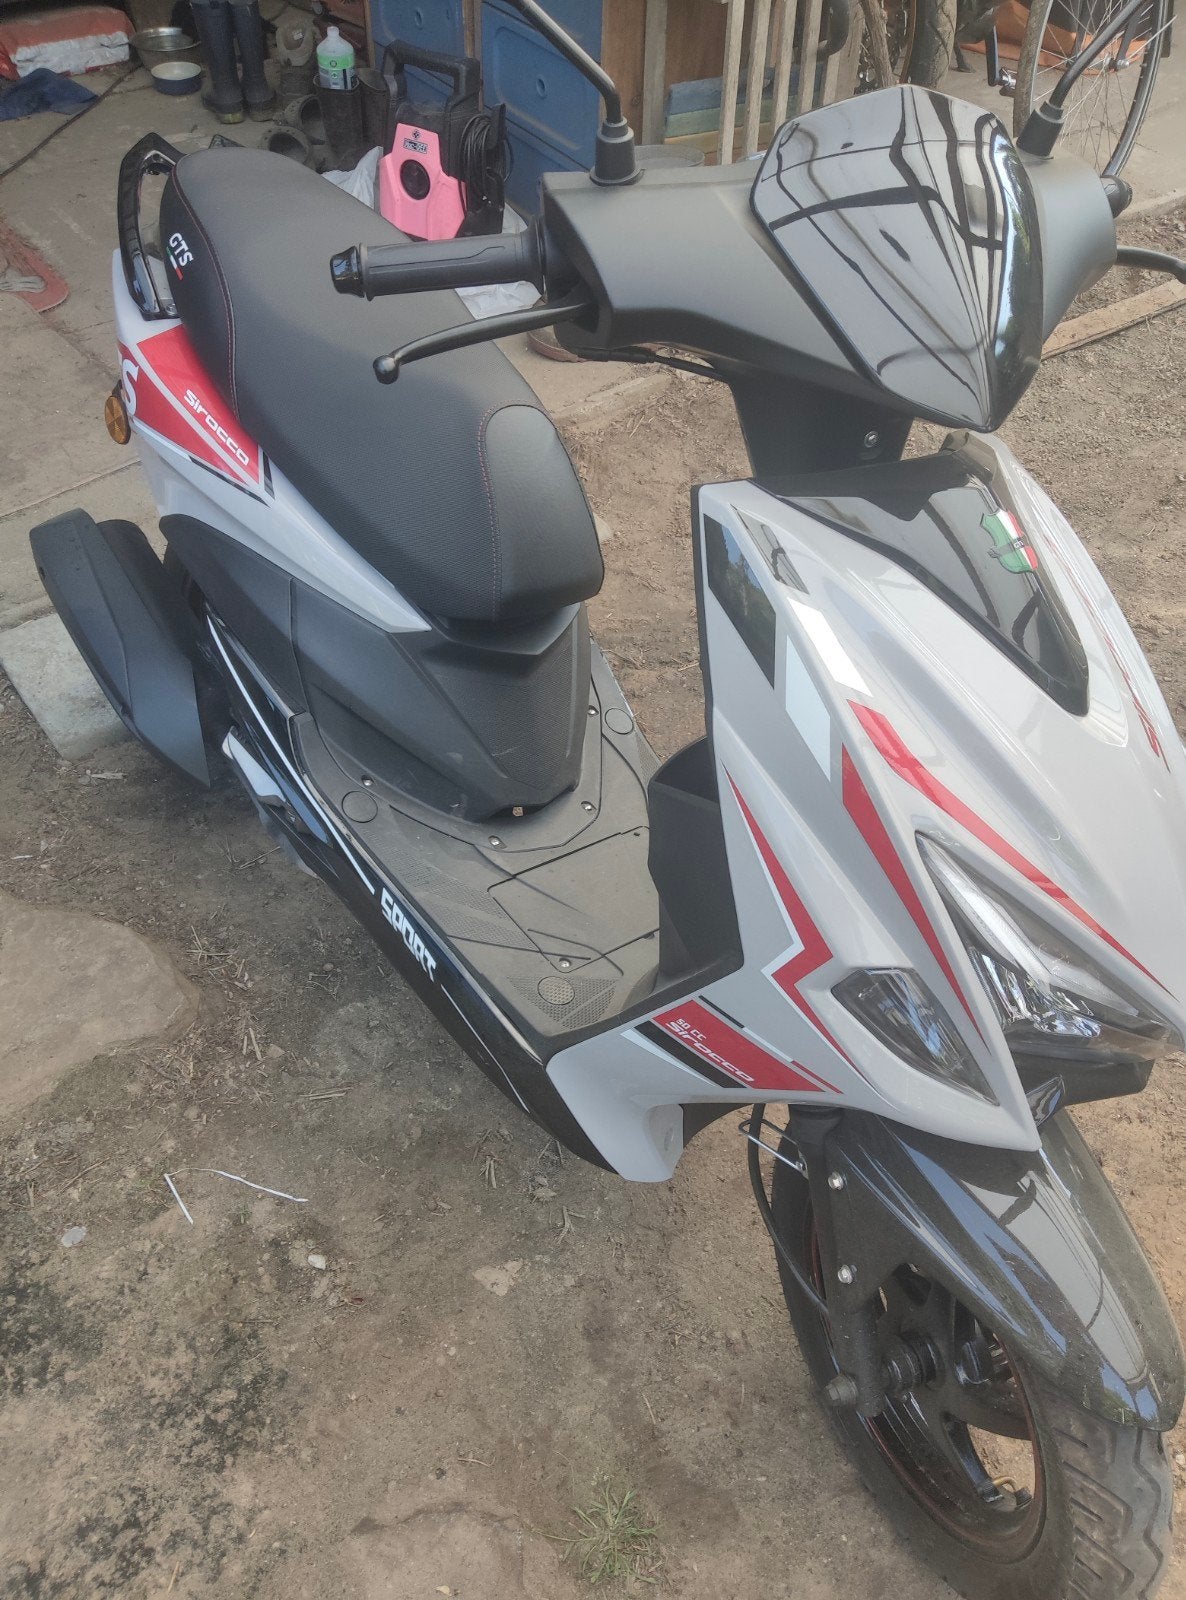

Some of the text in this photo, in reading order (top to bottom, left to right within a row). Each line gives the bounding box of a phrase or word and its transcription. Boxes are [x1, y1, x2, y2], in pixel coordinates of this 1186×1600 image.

[169, 232, 194, 267] GTS
[183, 389, 250, 466] Sirocco
[380, 887, 437, 983] SPORT
[665, 1021, 755, 1082] Sirocco
[675, 1018, 707, 1042] 50 CC
